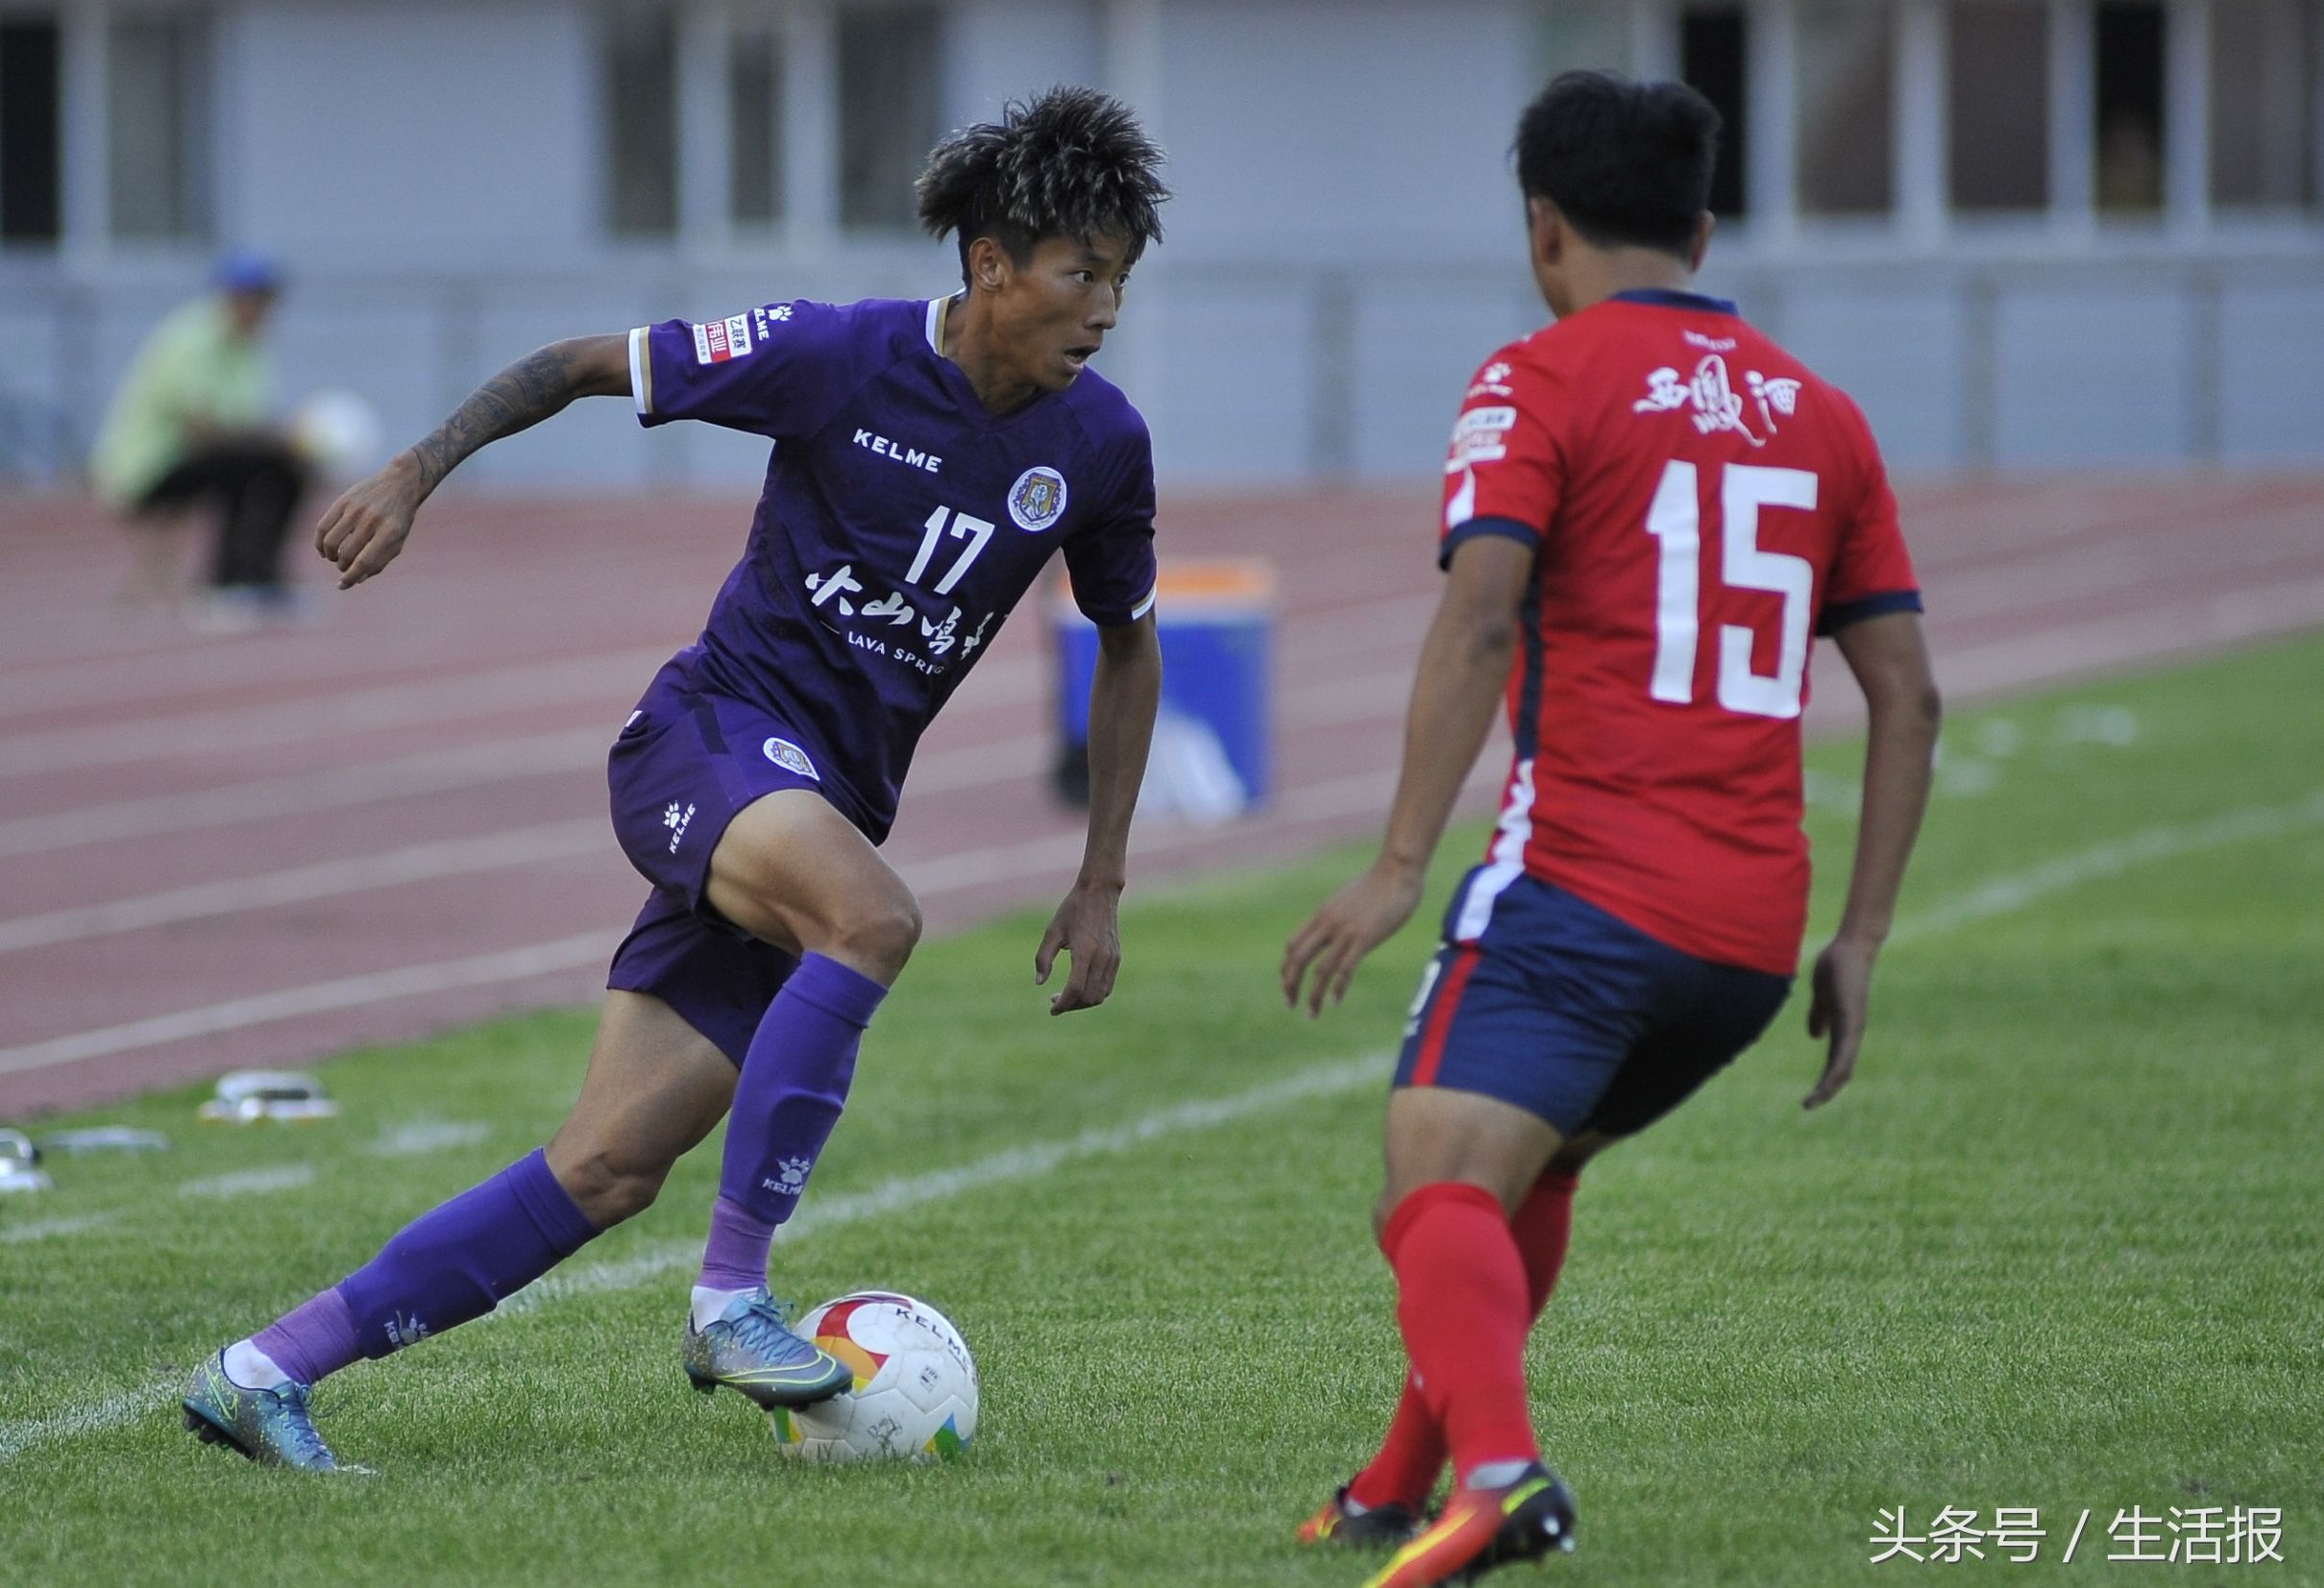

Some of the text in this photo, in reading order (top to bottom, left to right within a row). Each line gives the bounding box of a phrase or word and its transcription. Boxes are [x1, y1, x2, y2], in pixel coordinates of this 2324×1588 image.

[708, 321, 727, 354] 伟业
[853, 428, 942, 473] KELME
[904, 505, 995, 595] 17
[1646, 458, 1818, 719] 15
[848, 630, 886, 655] LAVA
[669, 802, 696, 854] KELME
[762, 1178, 803, 1195] KELM
